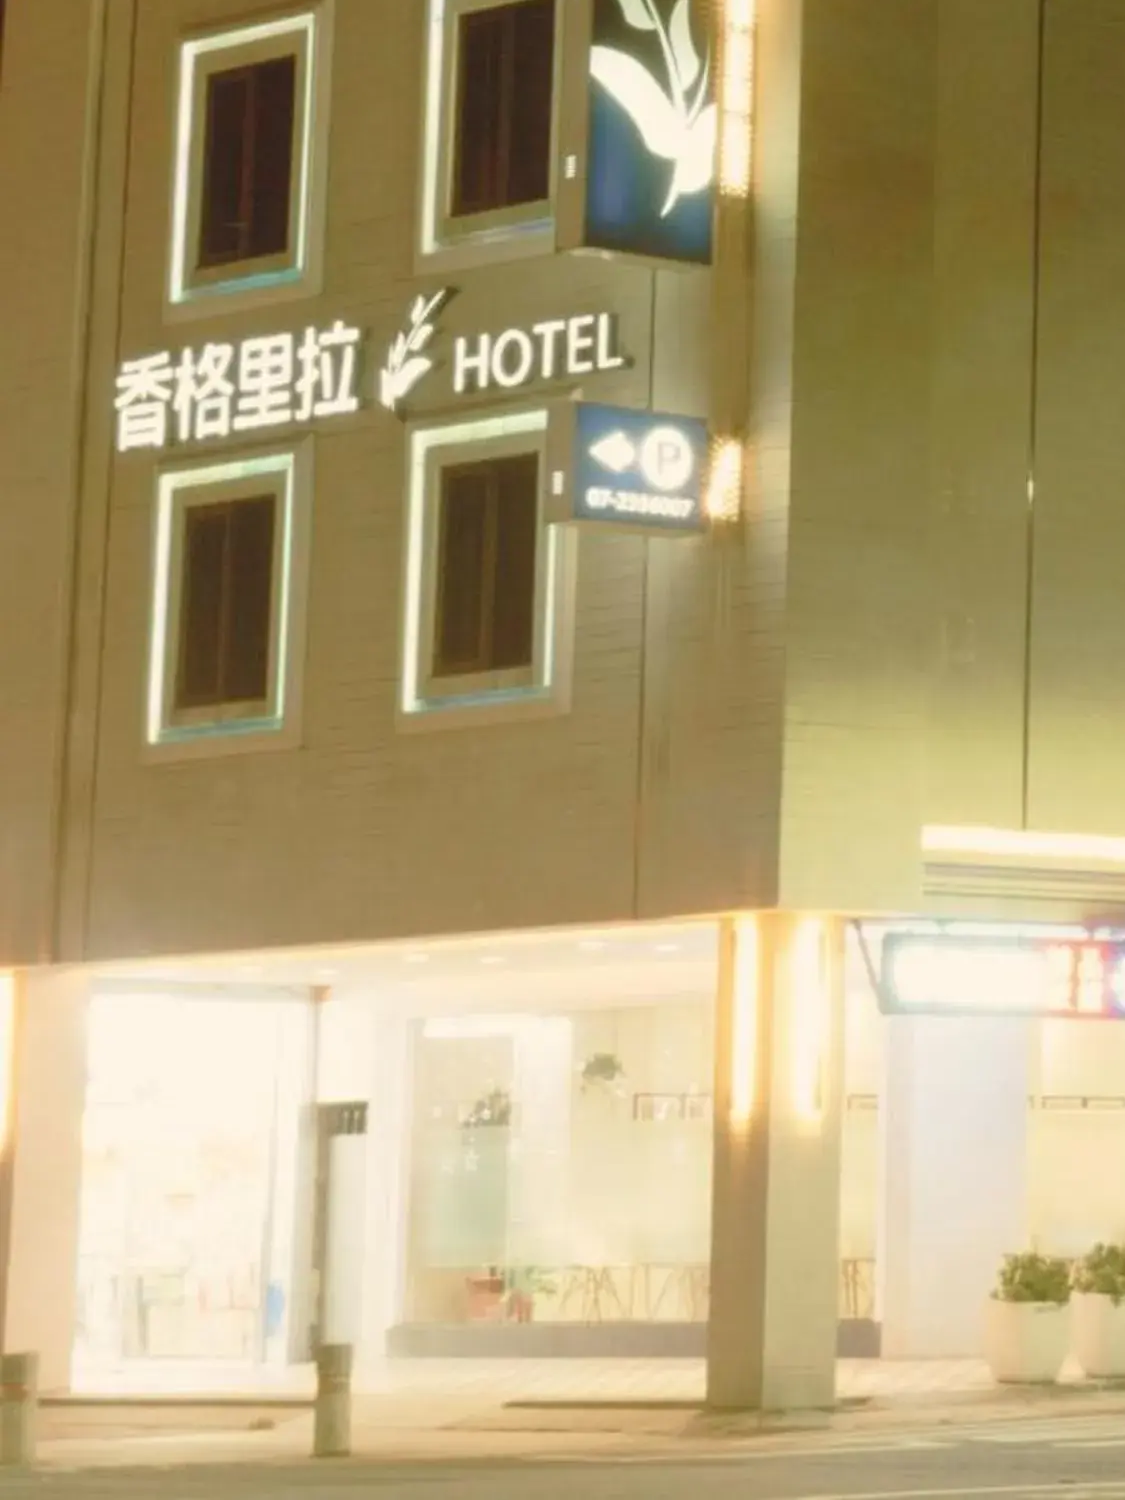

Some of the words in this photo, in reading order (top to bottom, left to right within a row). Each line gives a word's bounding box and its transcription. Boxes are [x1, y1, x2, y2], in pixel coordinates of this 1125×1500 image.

[113, 319, 361, 453] 香格里拉
[452, 312, 625, 393] HOTEL
